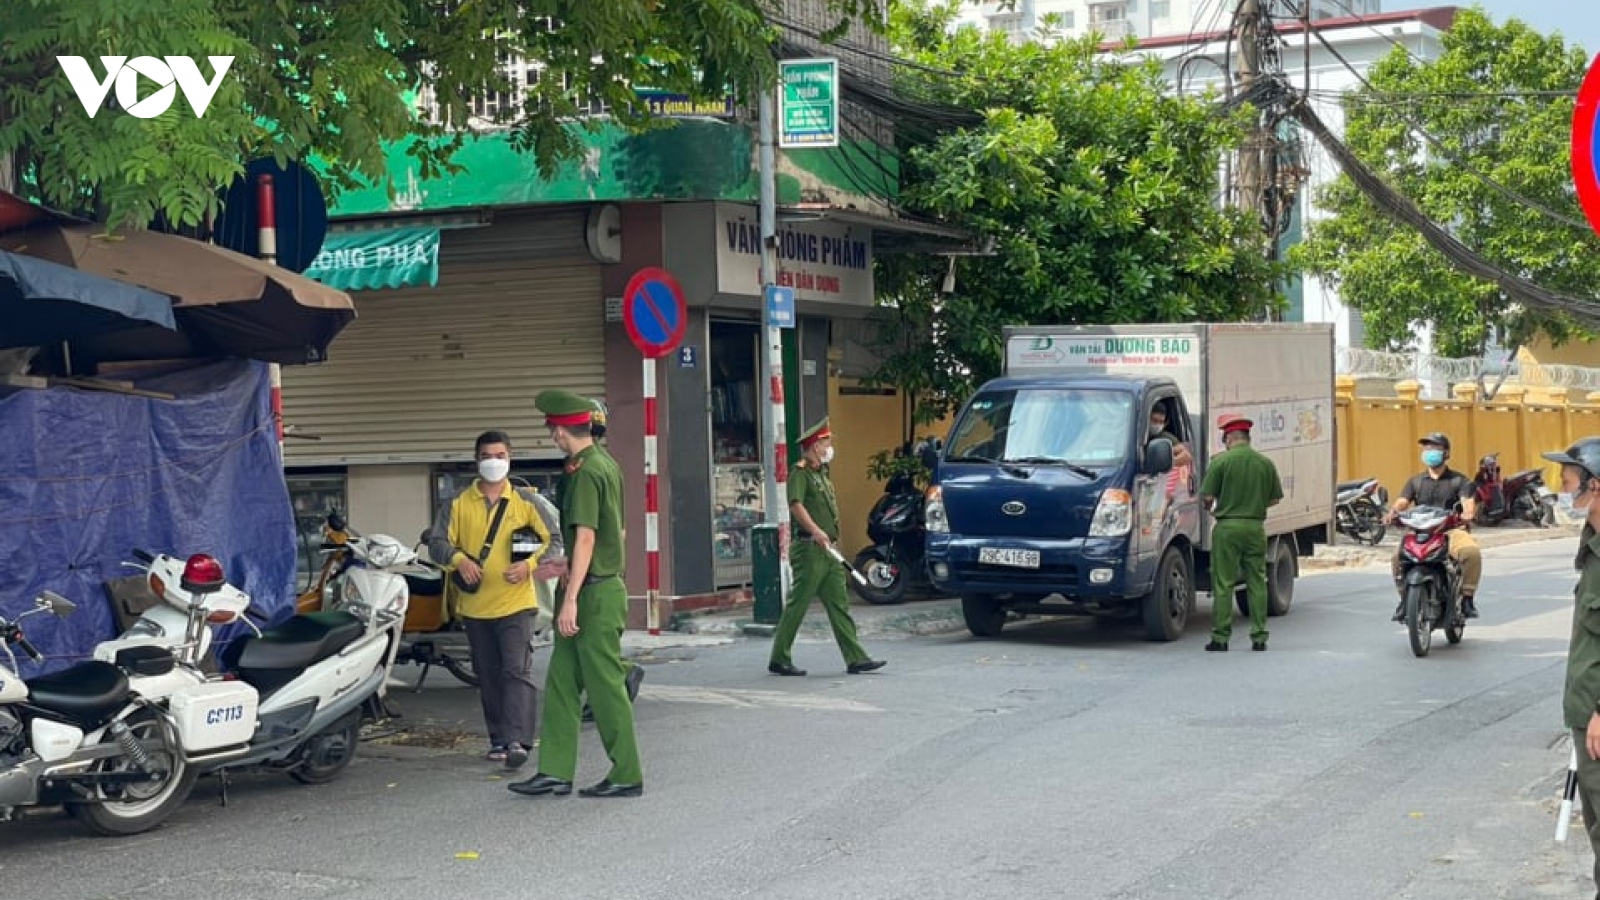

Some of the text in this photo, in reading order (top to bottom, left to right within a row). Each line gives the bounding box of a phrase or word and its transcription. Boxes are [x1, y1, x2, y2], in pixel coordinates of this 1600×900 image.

[727, 216, 867, 270] VĂN HÒNG PHẨM
[683, 347, 692, 362] 3
